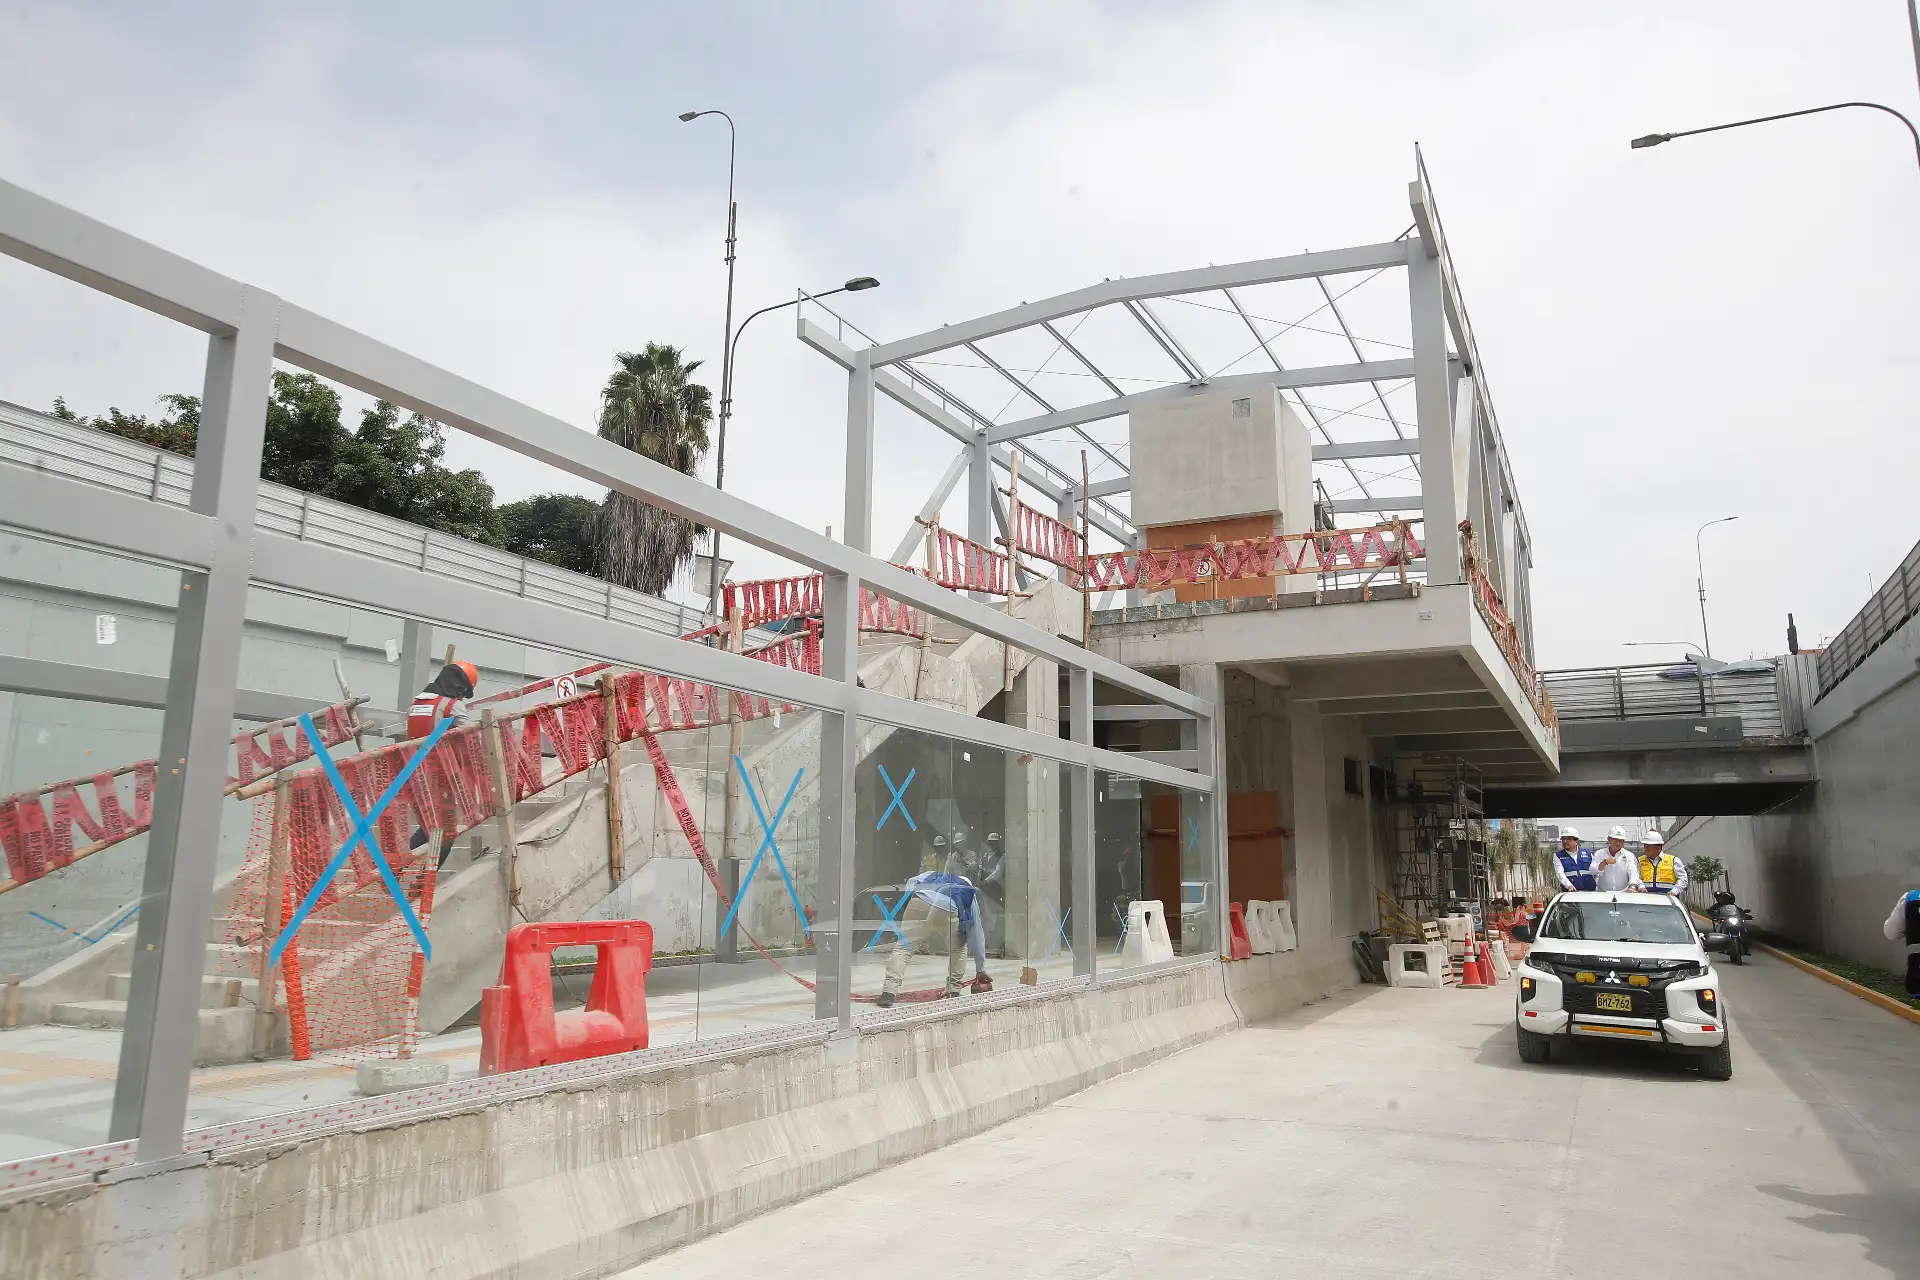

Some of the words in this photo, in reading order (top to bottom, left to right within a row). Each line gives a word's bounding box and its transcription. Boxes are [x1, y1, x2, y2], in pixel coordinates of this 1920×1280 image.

[657, 766, 672, 791] OBRAS
[662, 762, 678, 790] PELIGRO
[679, 807, 689, 820] NO
[683, 817, 699, 838] PASAR
[31, 843, 45, 874] PASAR
[700, 850, 716, 877] PELIGRO
[1597, 997, 1629, 1009] BMZ-762
